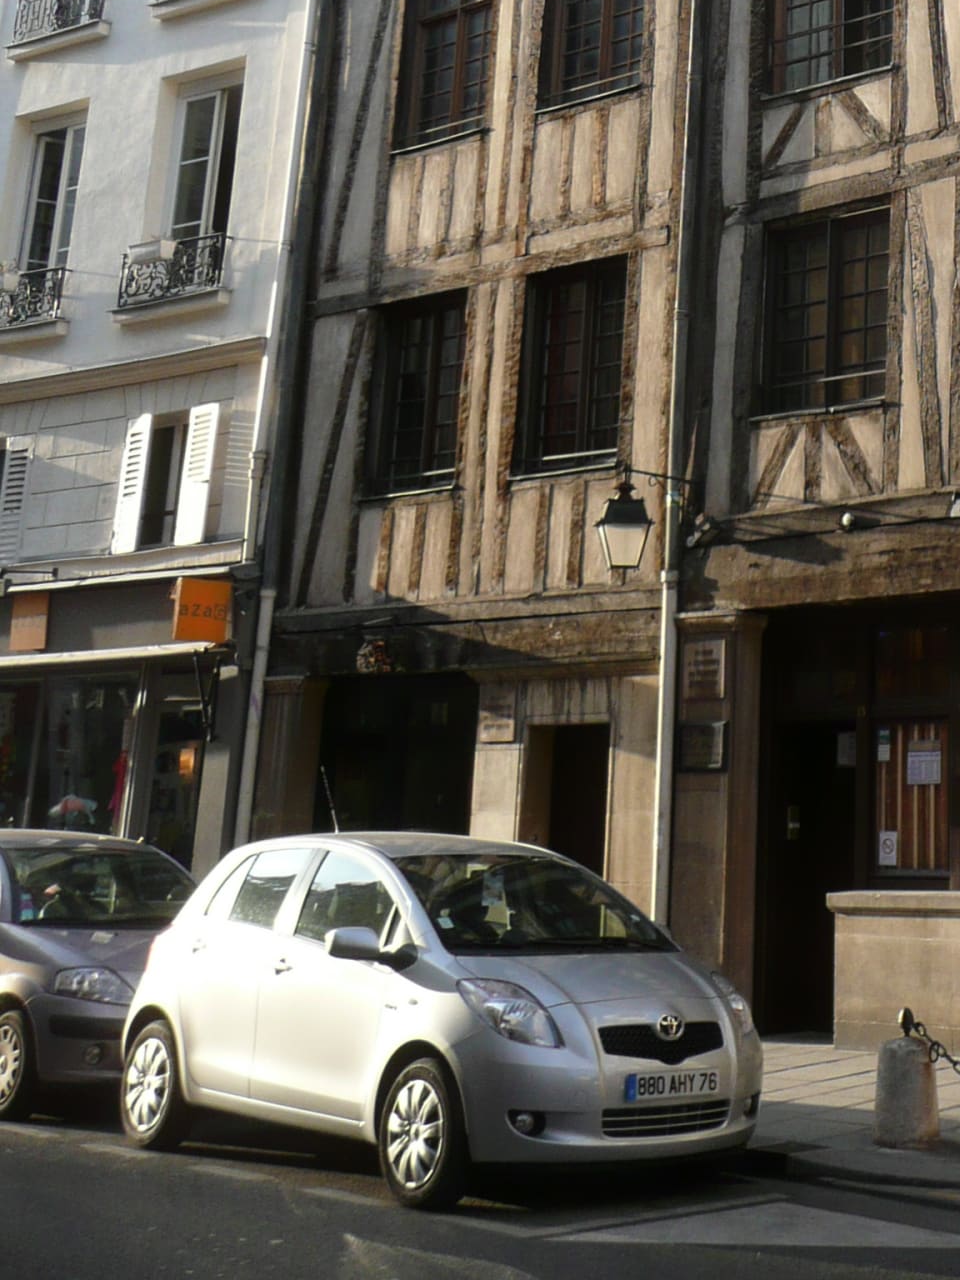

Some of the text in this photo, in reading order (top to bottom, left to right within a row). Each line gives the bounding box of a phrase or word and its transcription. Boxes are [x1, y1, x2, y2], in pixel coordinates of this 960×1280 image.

[638, 1072, 717, 1096] 880 AHY 76
